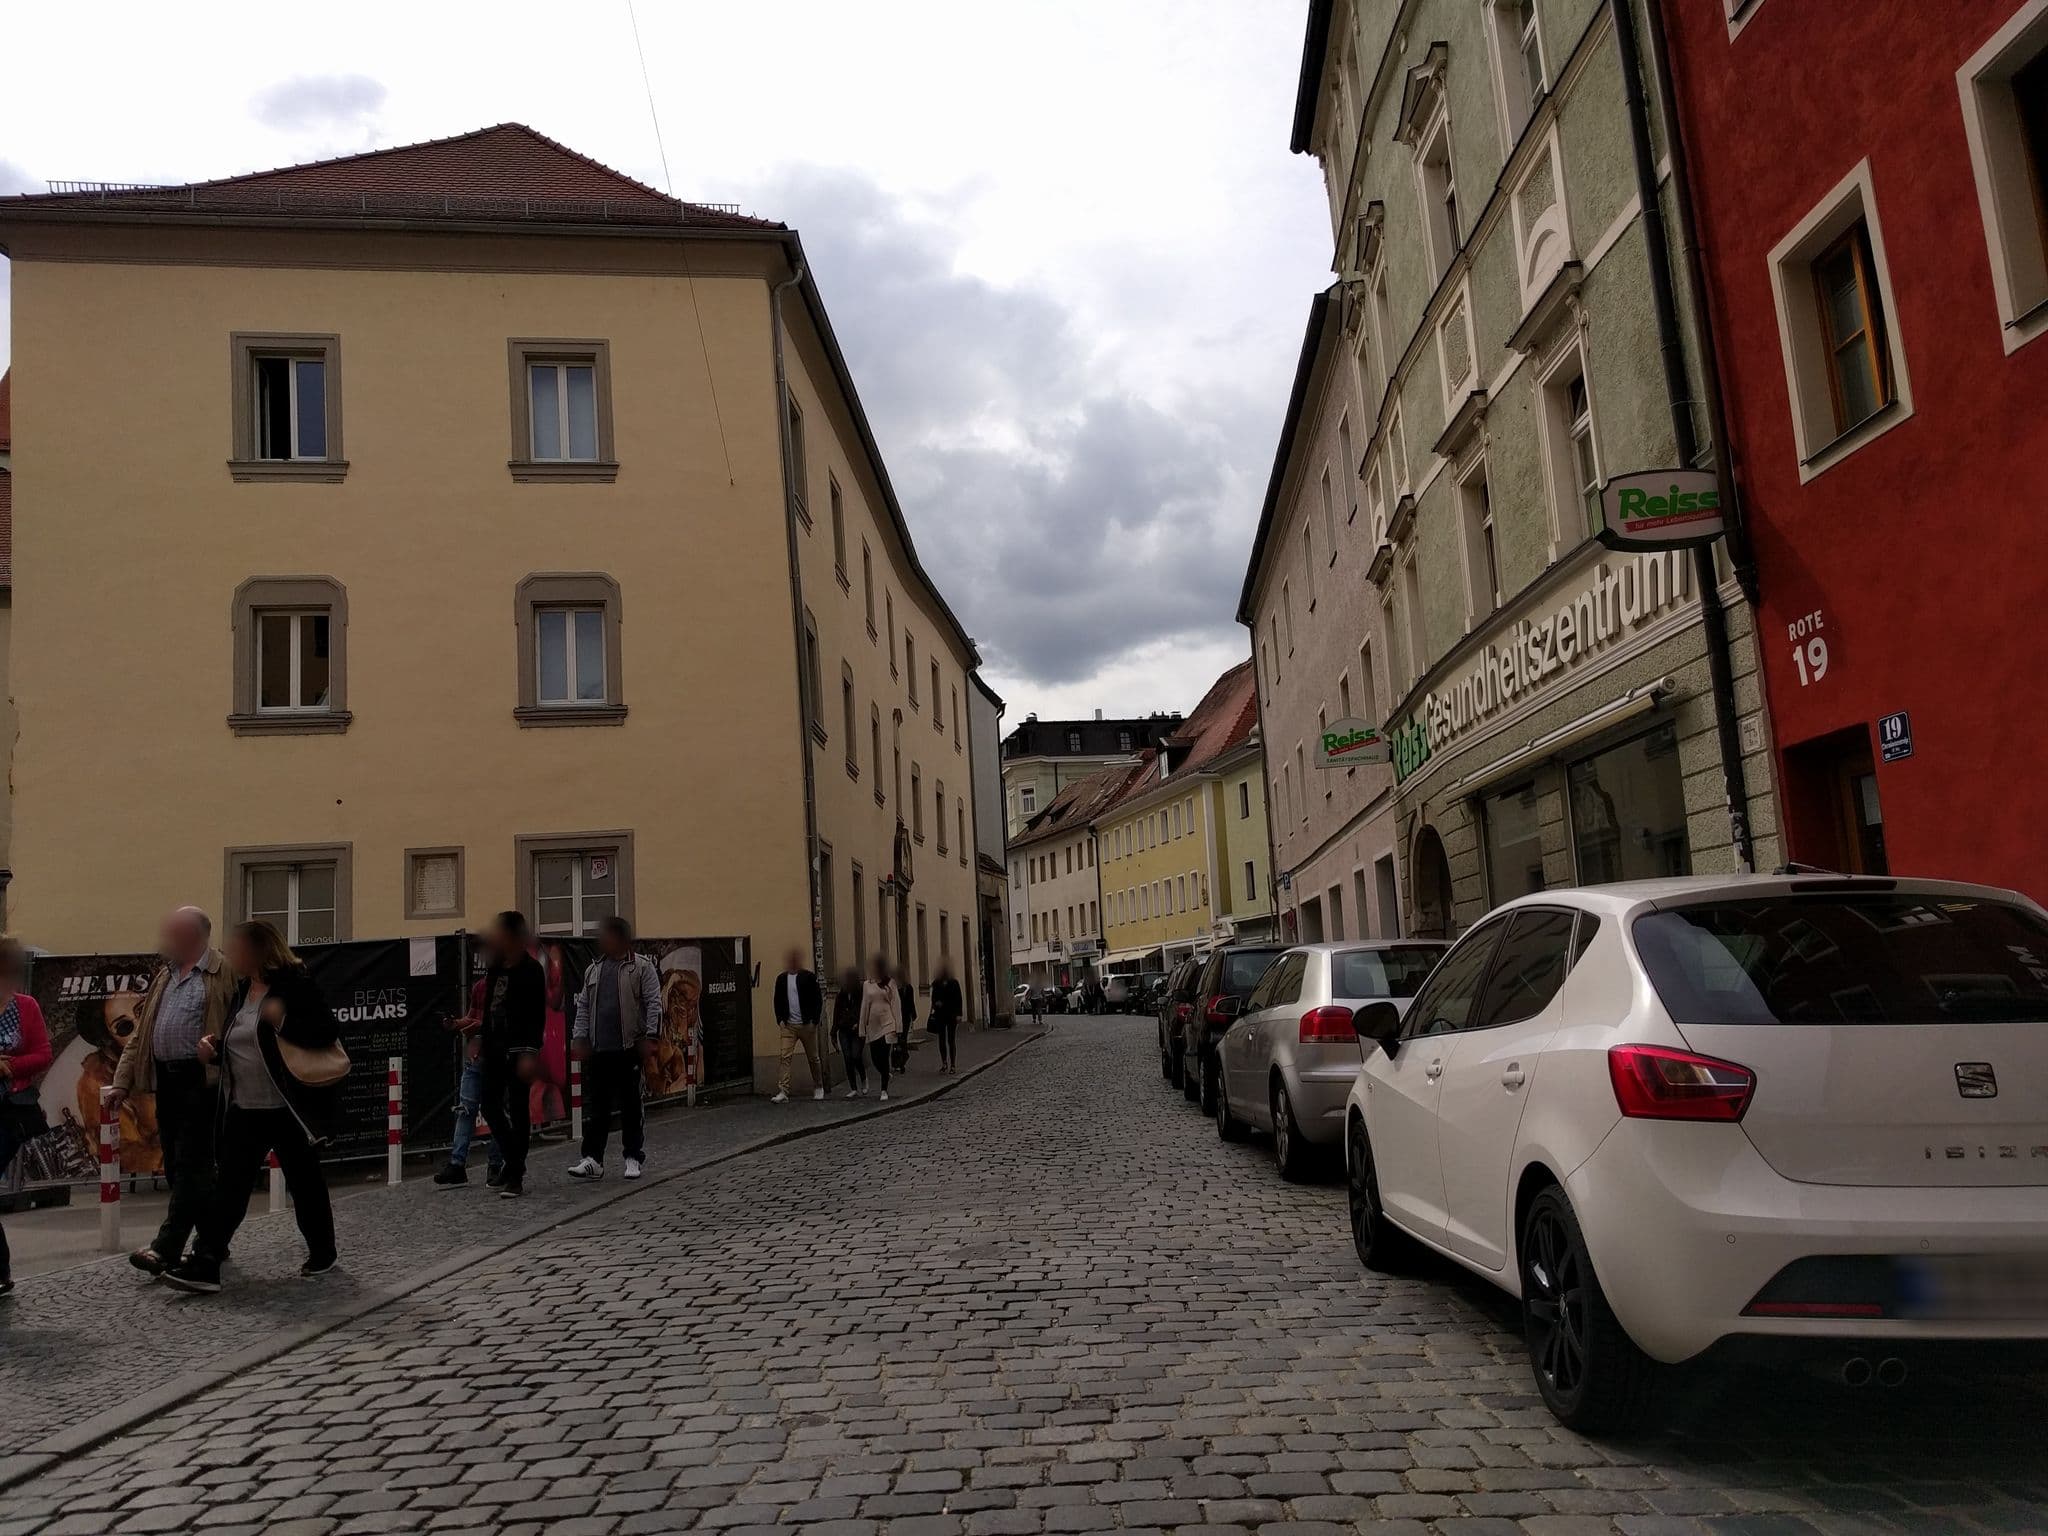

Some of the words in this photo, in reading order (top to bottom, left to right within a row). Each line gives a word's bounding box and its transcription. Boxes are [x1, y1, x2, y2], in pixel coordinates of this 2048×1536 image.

[1618, 484, 1718, 519] Reiss
[1788, 609, 1824, 641] ROTE
[1424, 549, 1684, 750] Gesundheitszentrum
[1793, 636, 1828, 687] 19
[1322, 728, 1376, 752] Reiss
[1882, 716, 1902, 741] 19
[354, 987, 408, 1006] BEATS
[708, 982, 737, 994] REGULARS
